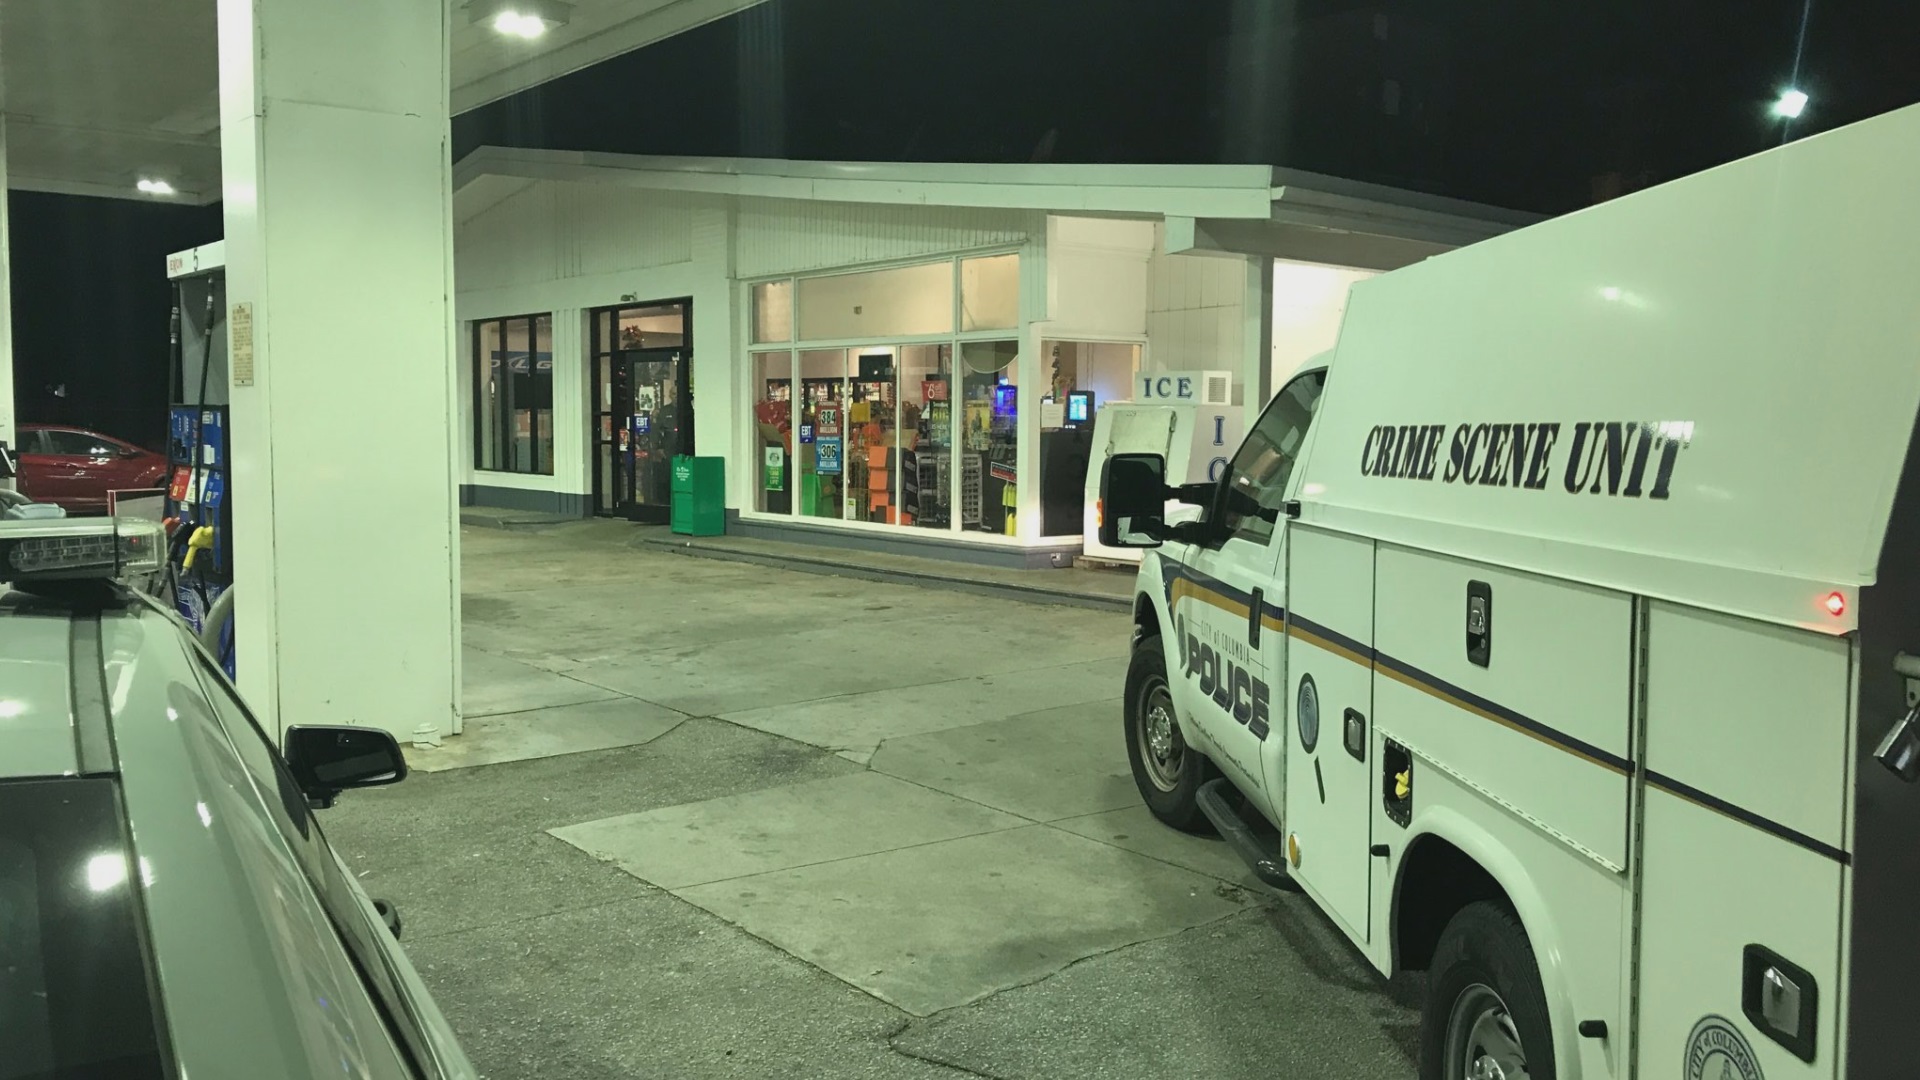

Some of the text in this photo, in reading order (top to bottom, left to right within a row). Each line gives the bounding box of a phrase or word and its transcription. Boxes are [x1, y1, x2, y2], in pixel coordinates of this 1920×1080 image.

[193, 247, 199, 272] 5
[928, 383, 935, 399] 6
[1143, 377, 1193, 399] ICE
[636, 417, 648, 427] EBT
[821, 409, 837, 424] 384
[801, 425, 811, 436] EBT
[819, 426, 838, 434] MILLION
[821, 444, 837, 458] 306
[1361, 421, 1695, 500] CRIME SCENE UNIT
[1201, 619, 1212, 641] CITY
[1221, 632, 1250, 665] COLUMBIA
[1185, 632, 1270, 742] POLICE
[1711, 1030, 1755, 1080] COLUMBI
